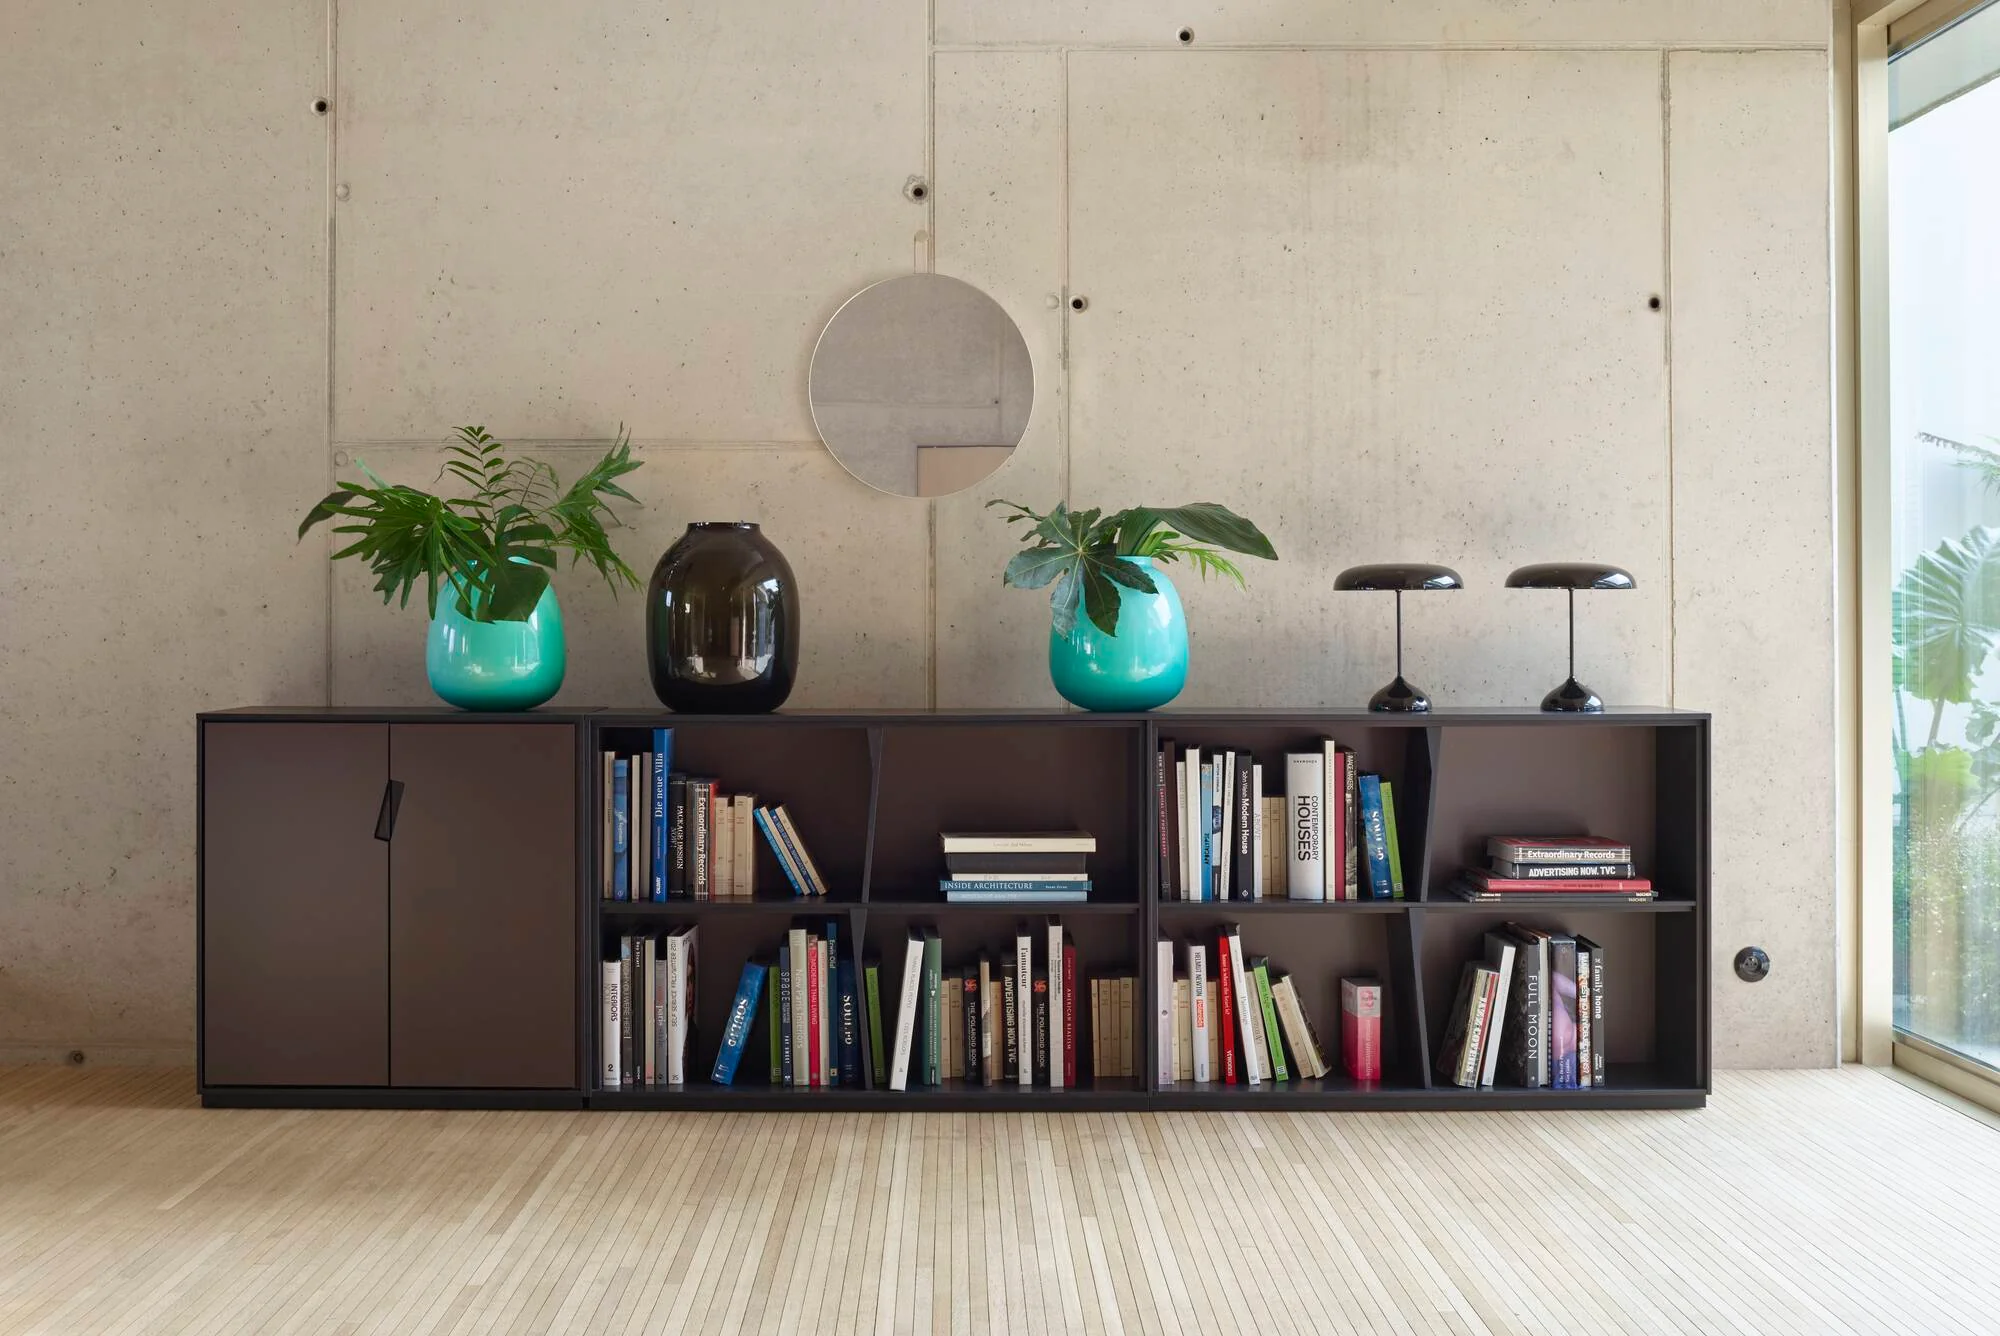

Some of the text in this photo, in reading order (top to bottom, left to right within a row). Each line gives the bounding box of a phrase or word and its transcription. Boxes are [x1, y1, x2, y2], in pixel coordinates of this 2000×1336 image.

[655, 753, 664, 774] Villa
[655, 802, 664, 818] Die
[696, 798, 706, 852] Extraordinary
[1298, 796, 1310, 861] HOUSES
[1528, 851, 1616, 860] Extraordinary Records
[1528, 866, 1616, 877] ADVERTISING NOW. TVC
[794, 969, 802, 988] New
[1020, 948, 1028, 988] l'amateur
[1593, 964, 1602, 992] family
[1004, 976, 1014, 1026] ADVERTISING
[1528, 975, 1537, 1059] FULL MOON
[1008, 1048, 1016, 1063] TVC
[608, 1064, 614, 1072] 2
